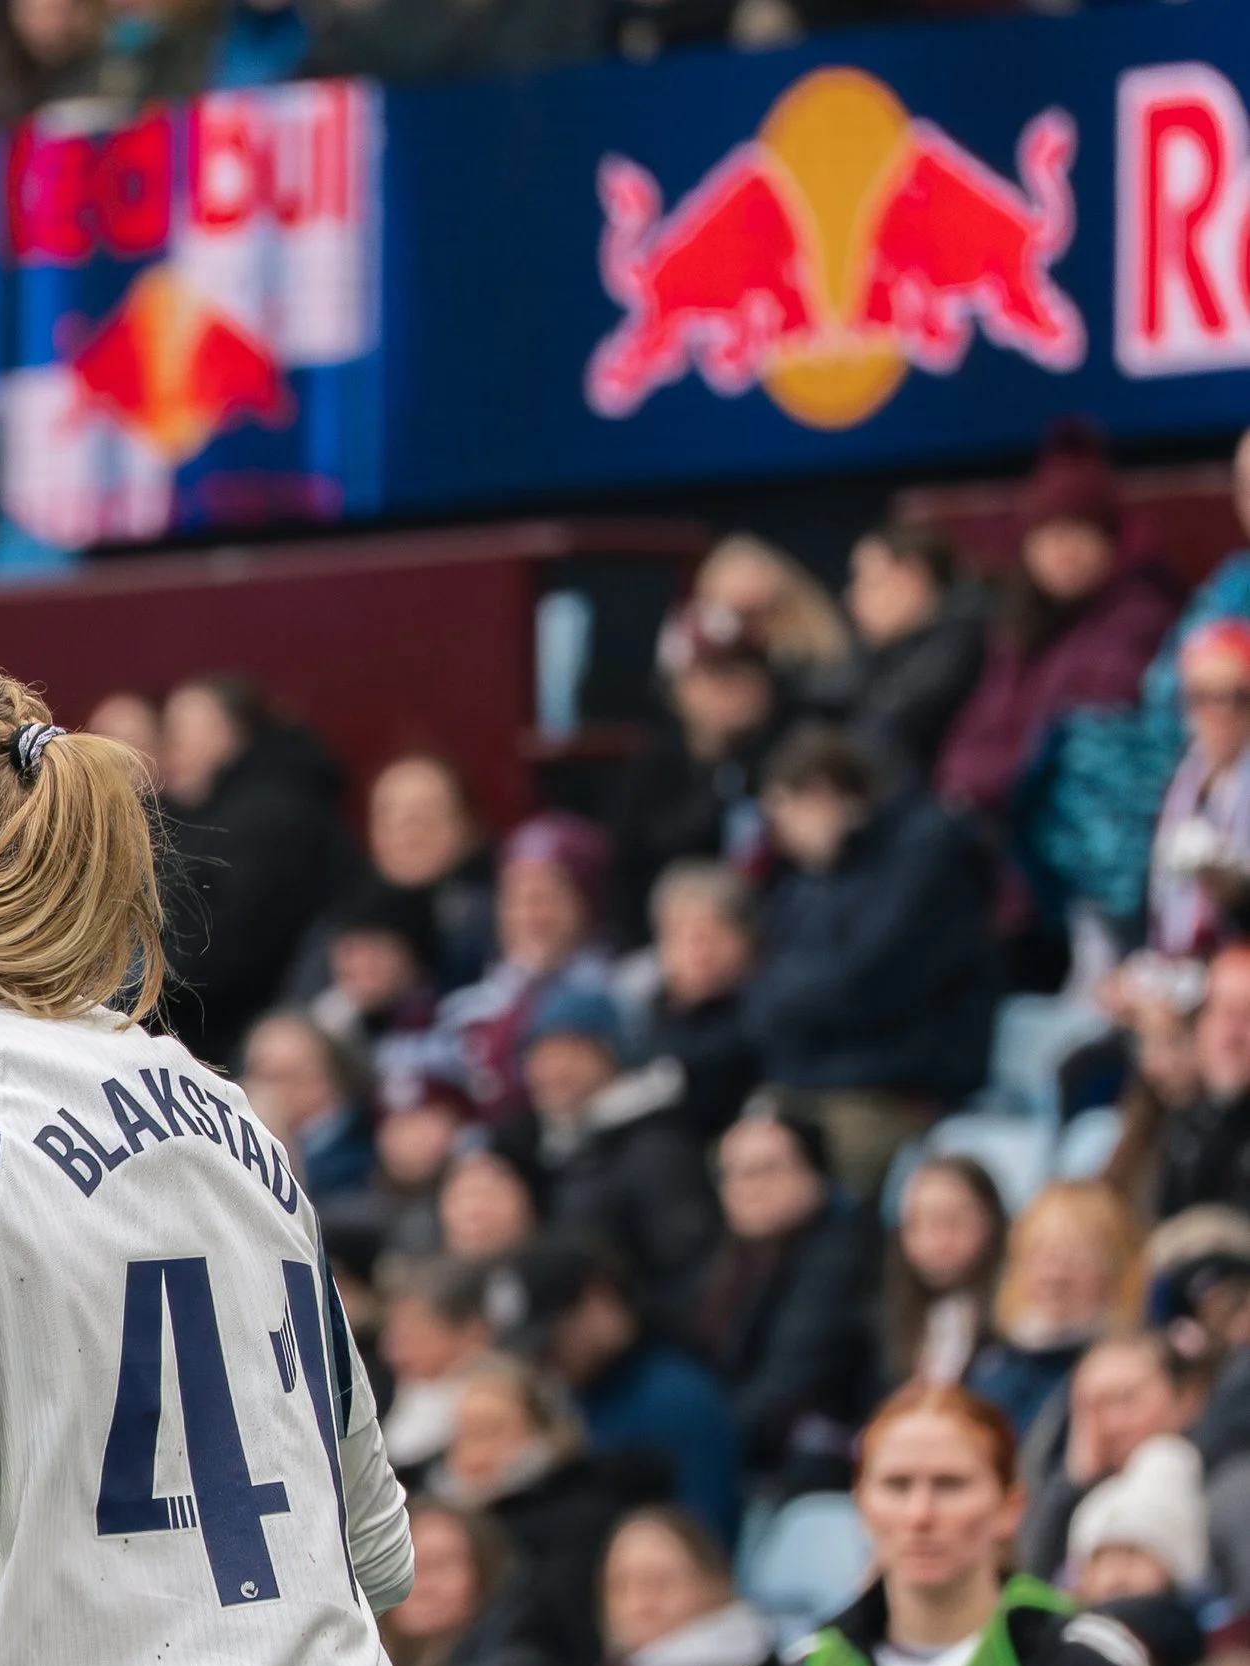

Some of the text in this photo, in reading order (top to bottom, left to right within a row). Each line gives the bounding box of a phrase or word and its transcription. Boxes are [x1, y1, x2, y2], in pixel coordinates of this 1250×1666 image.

[1126, 76, 1250, 364] R
[32, 1067, 298, 1215] BLAKSTAD
[96, 1256, 360, 1608] 41
